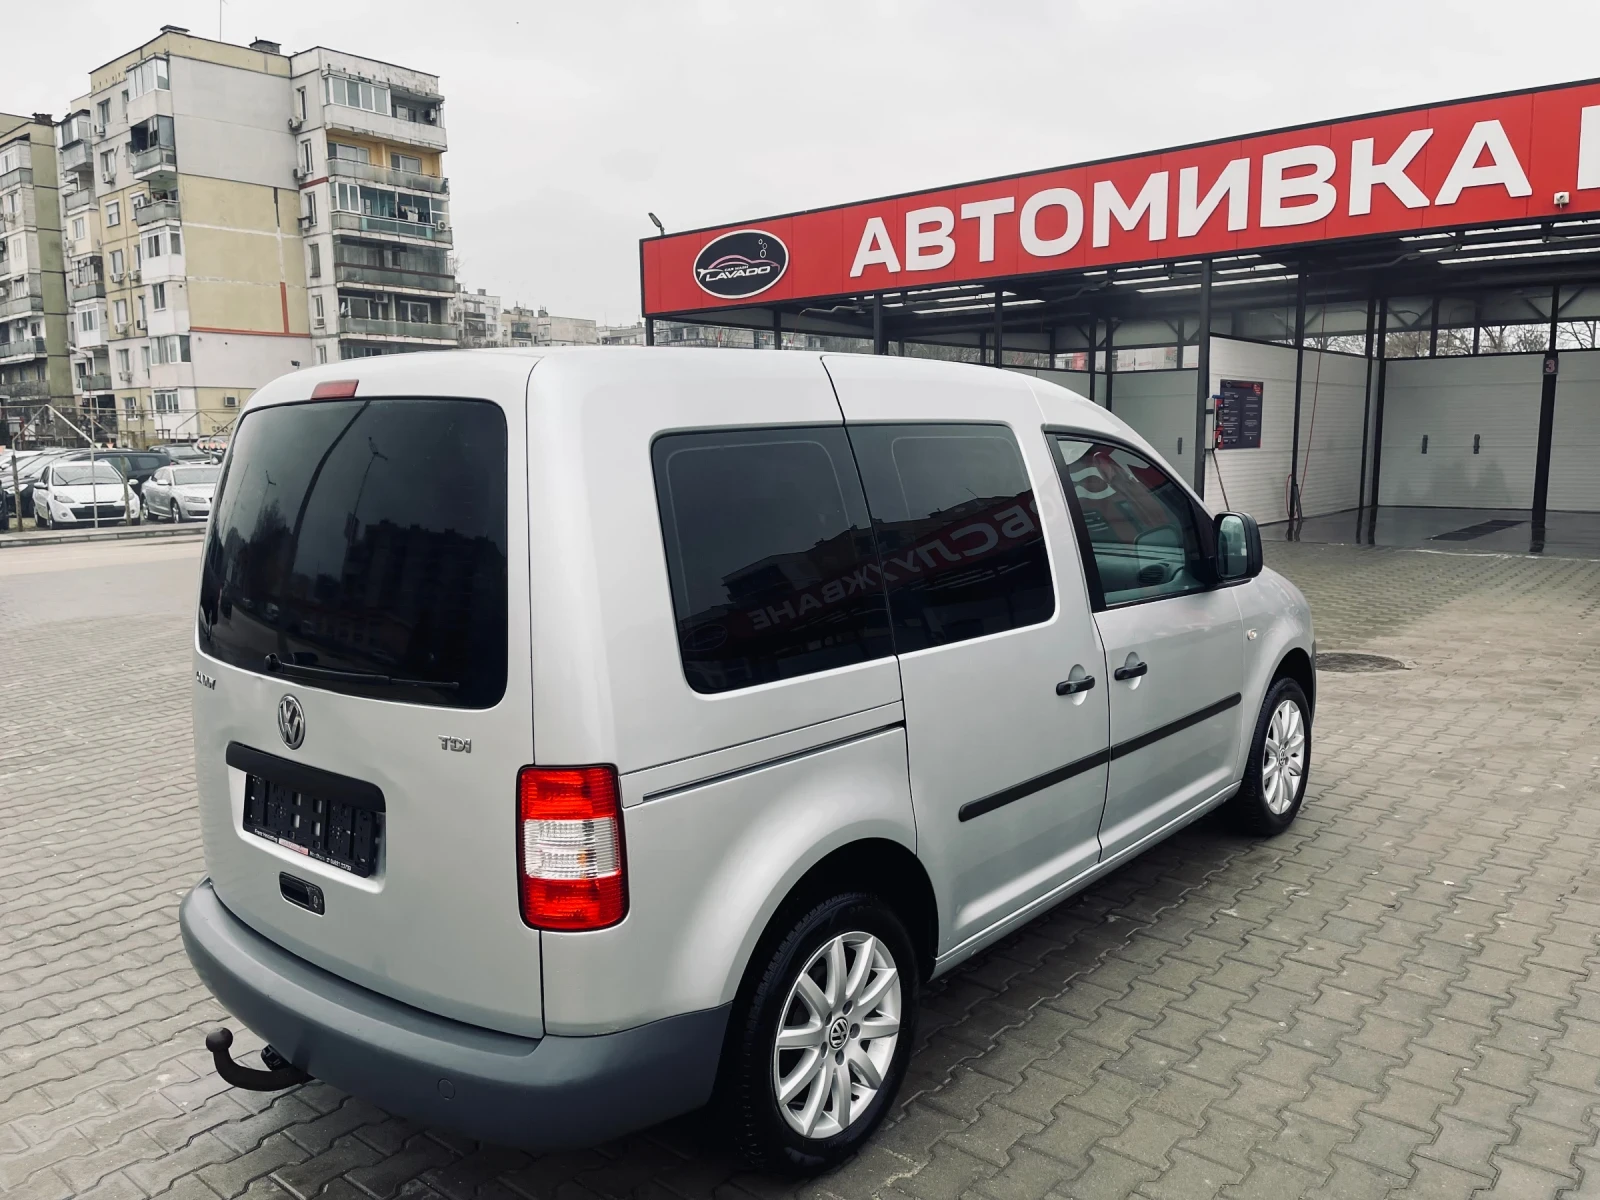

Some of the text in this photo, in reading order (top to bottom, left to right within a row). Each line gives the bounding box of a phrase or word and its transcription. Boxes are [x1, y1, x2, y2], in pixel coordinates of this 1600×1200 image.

[849, 119, 1533, 278] АВТОМИВКА
[705, 265, 771, 282] LAVADO
[1545, 359, 1556, 373] 3
[438, 734, 472, 754] TDI
